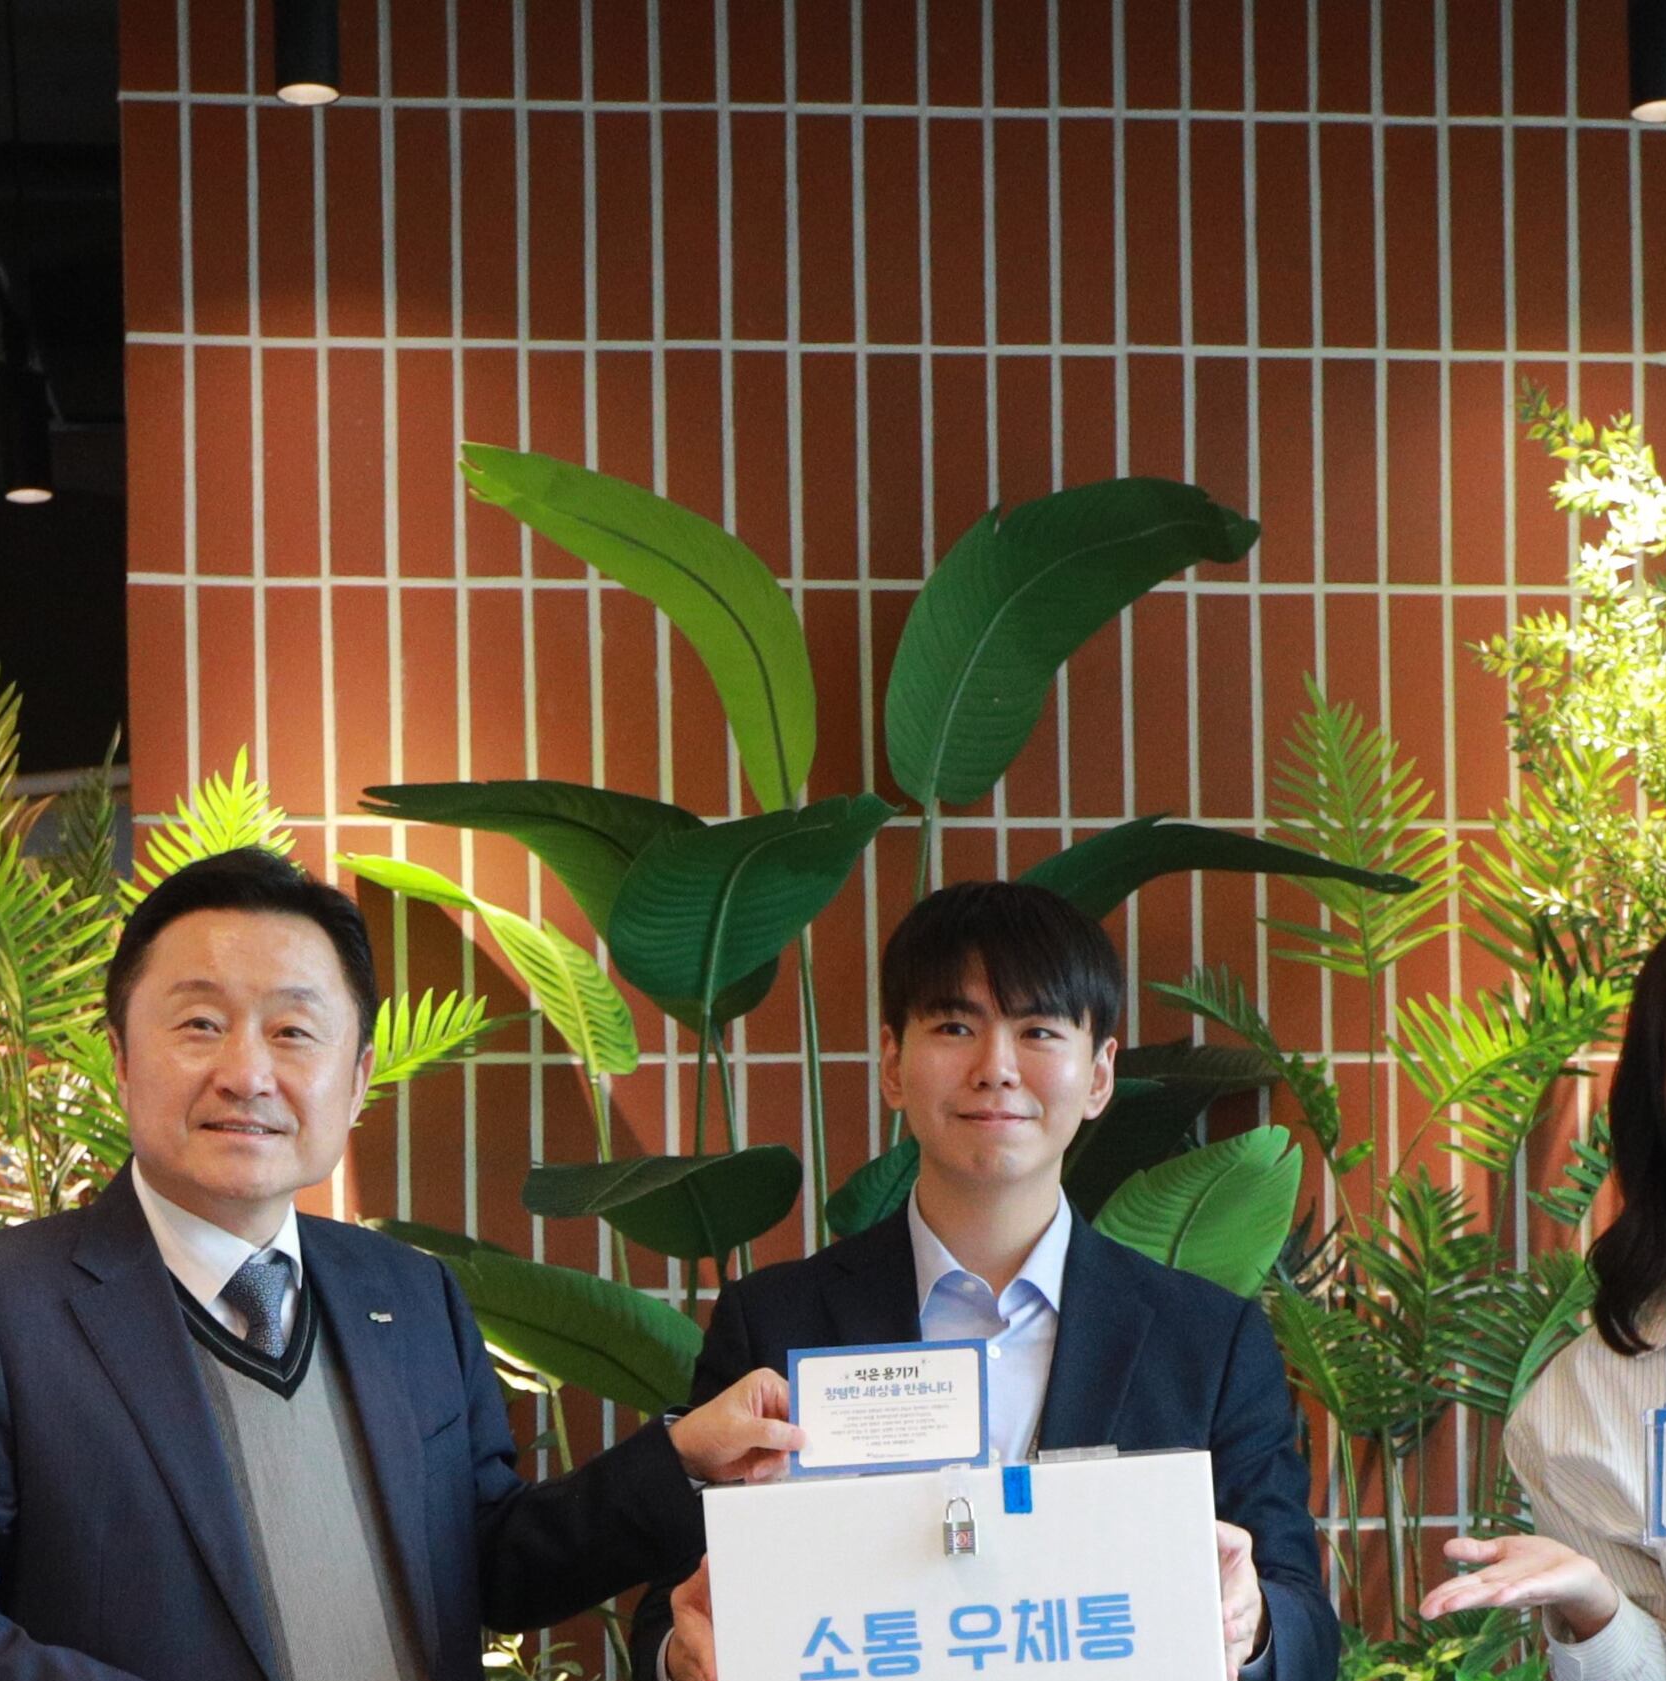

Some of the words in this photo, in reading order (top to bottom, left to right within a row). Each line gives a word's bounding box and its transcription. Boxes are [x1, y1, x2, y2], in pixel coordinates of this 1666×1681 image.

[854, 1368, 879, 1382] 작은
[883, 1366, 919, 1380] 용기가
[863, 1383, 901, 1398] 세상을
[904, 1381, 953, 1396] 만듭니다
[799, 1610, 923, 1681] 소통
[947, 1593, 1135, 1671] 우체통
